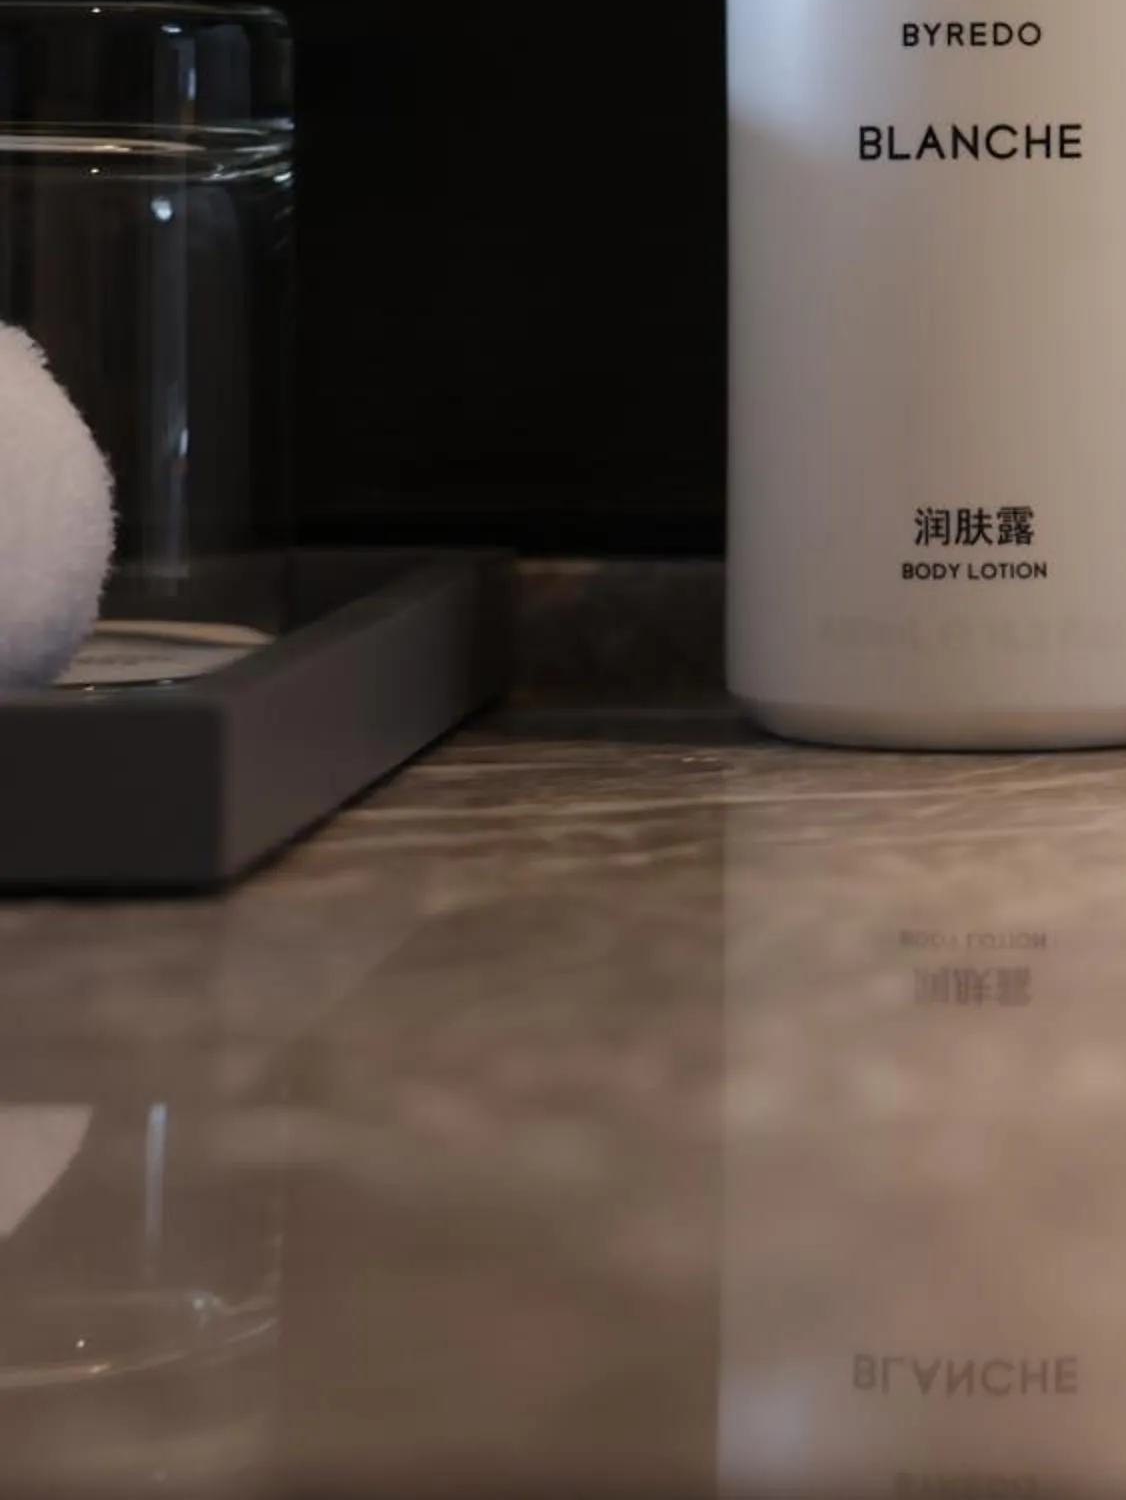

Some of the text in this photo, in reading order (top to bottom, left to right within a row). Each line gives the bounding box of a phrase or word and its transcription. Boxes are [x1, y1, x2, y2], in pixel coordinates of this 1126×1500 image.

[902, 21, 1043, 48] BYREDO
[859, 123, 1083, 161] BLANCHE
[914, 506, 1035, 546] 润肤露
[901, 561, 1048, 581] BODY LOTION
